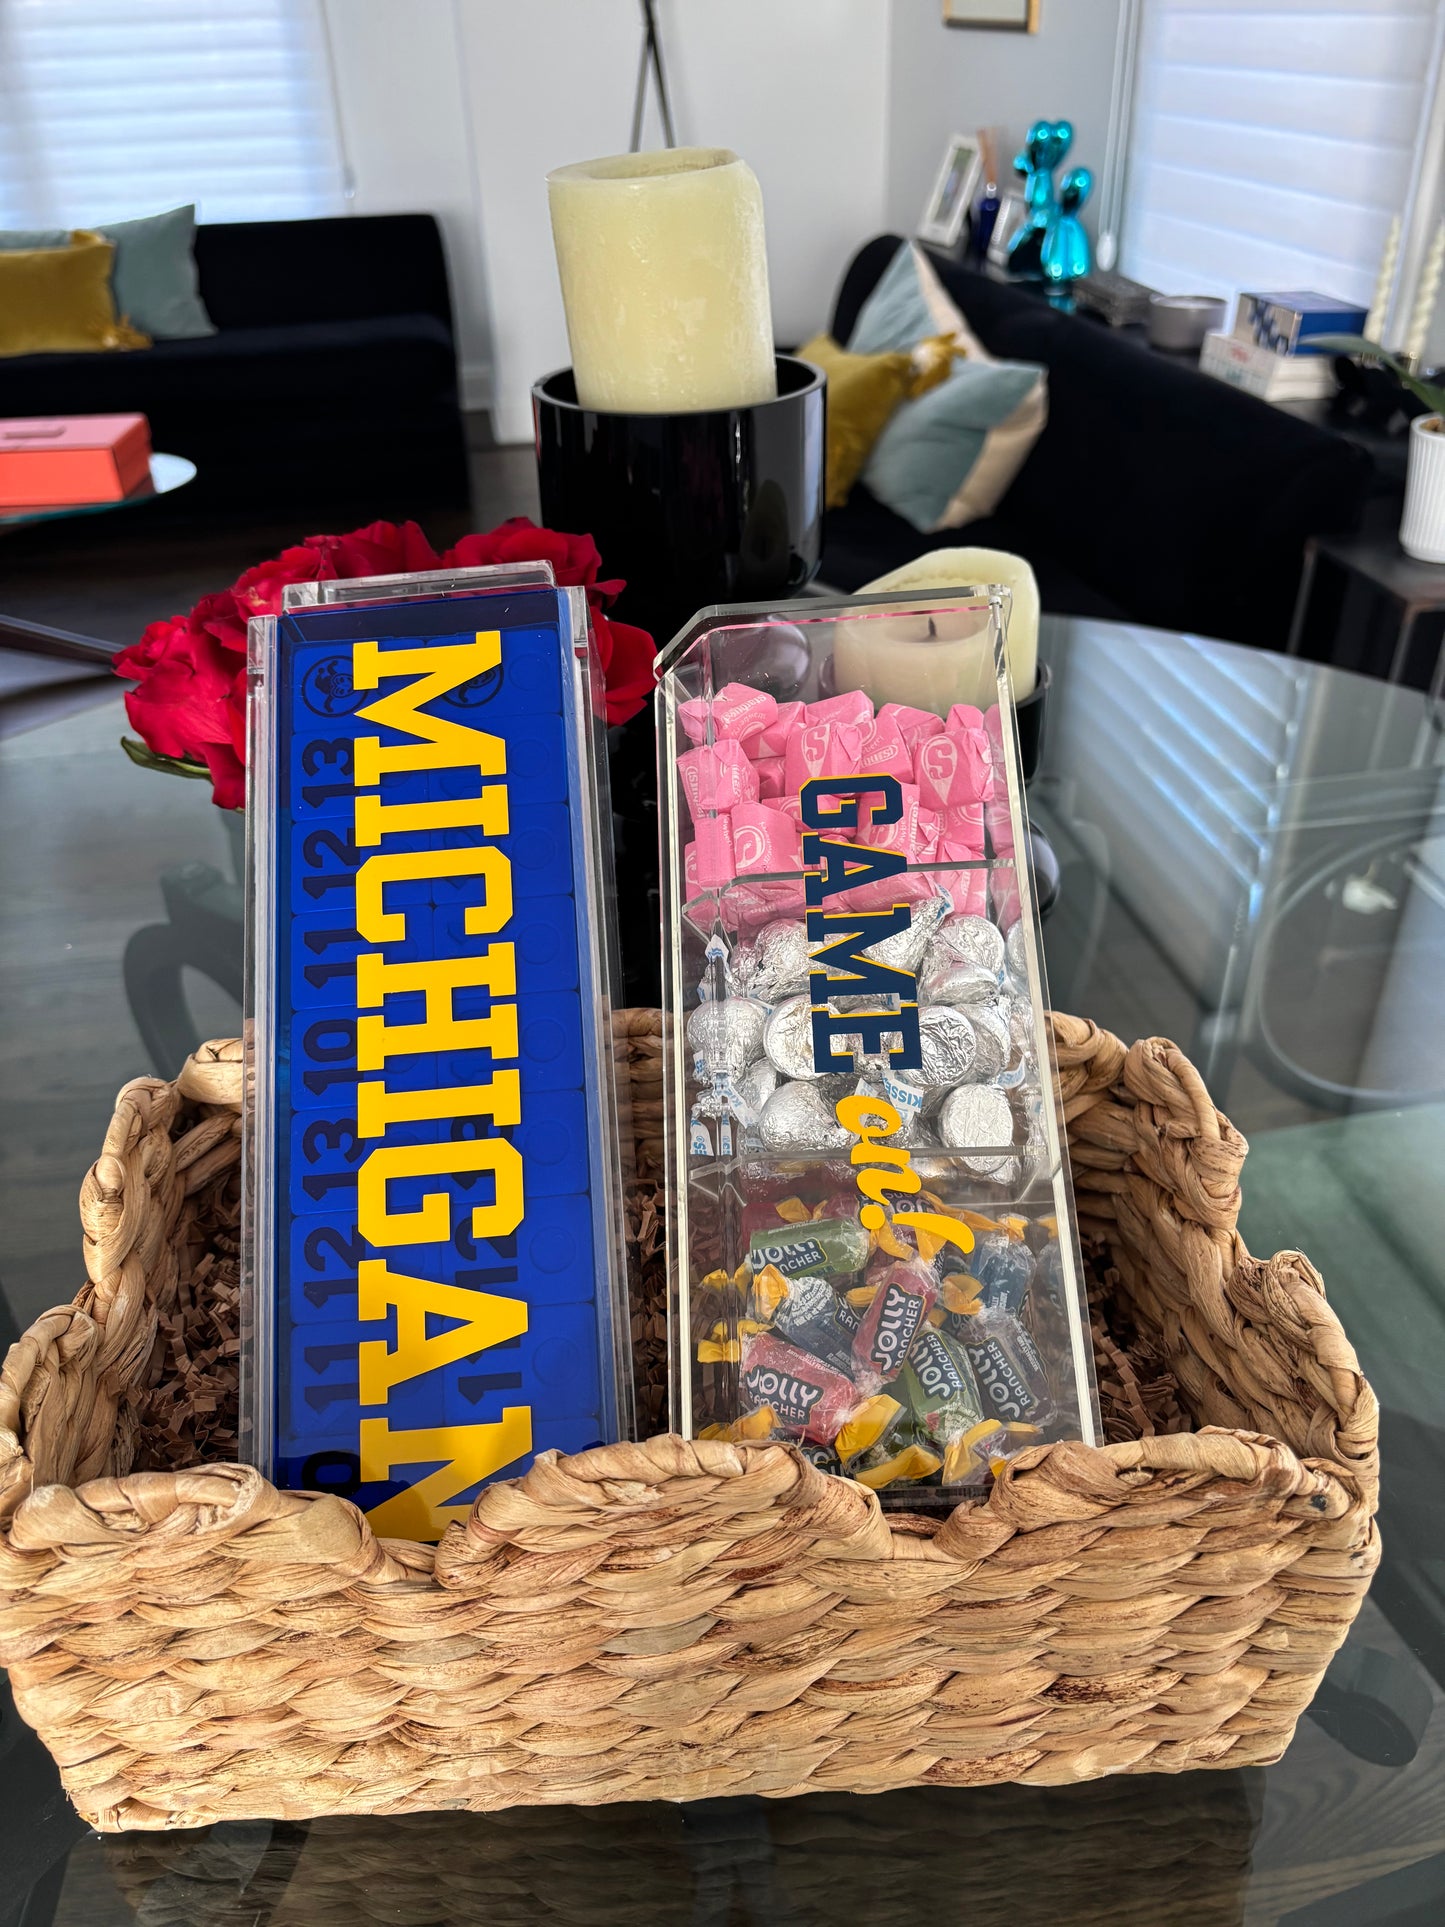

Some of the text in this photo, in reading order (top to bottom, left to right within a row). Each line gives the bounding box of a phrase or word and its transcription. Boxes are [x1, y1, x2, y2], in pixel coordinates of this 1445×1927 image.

[302, 737, 360, 810] 13
[303, 827, 359, 900] 12
[303, 927, 361, 990] 11
[799, 773, 923, 1074] GAME
[303, 1018, 364, 1097] 10
[353, 630, 533, 1541] MICHIGAN
[302, 1117, 365, 1202] 13
[303, 1224, 366, 1311] 12
[779, 1251, 822, 1274] NCHER
[875, 1288, 906, 1371] JOLLY
[926, 1334, 963, 1388] RANCHER
[304, 1342, 361, 1417] 11
[746, 1369, 818, 1408] JOLLY
[910, 1339, 951, 1398] JOLLY
[968, 1346, 1021, 1419] JOLLY
[987, 1341, 1031, 1407] RANCHER
